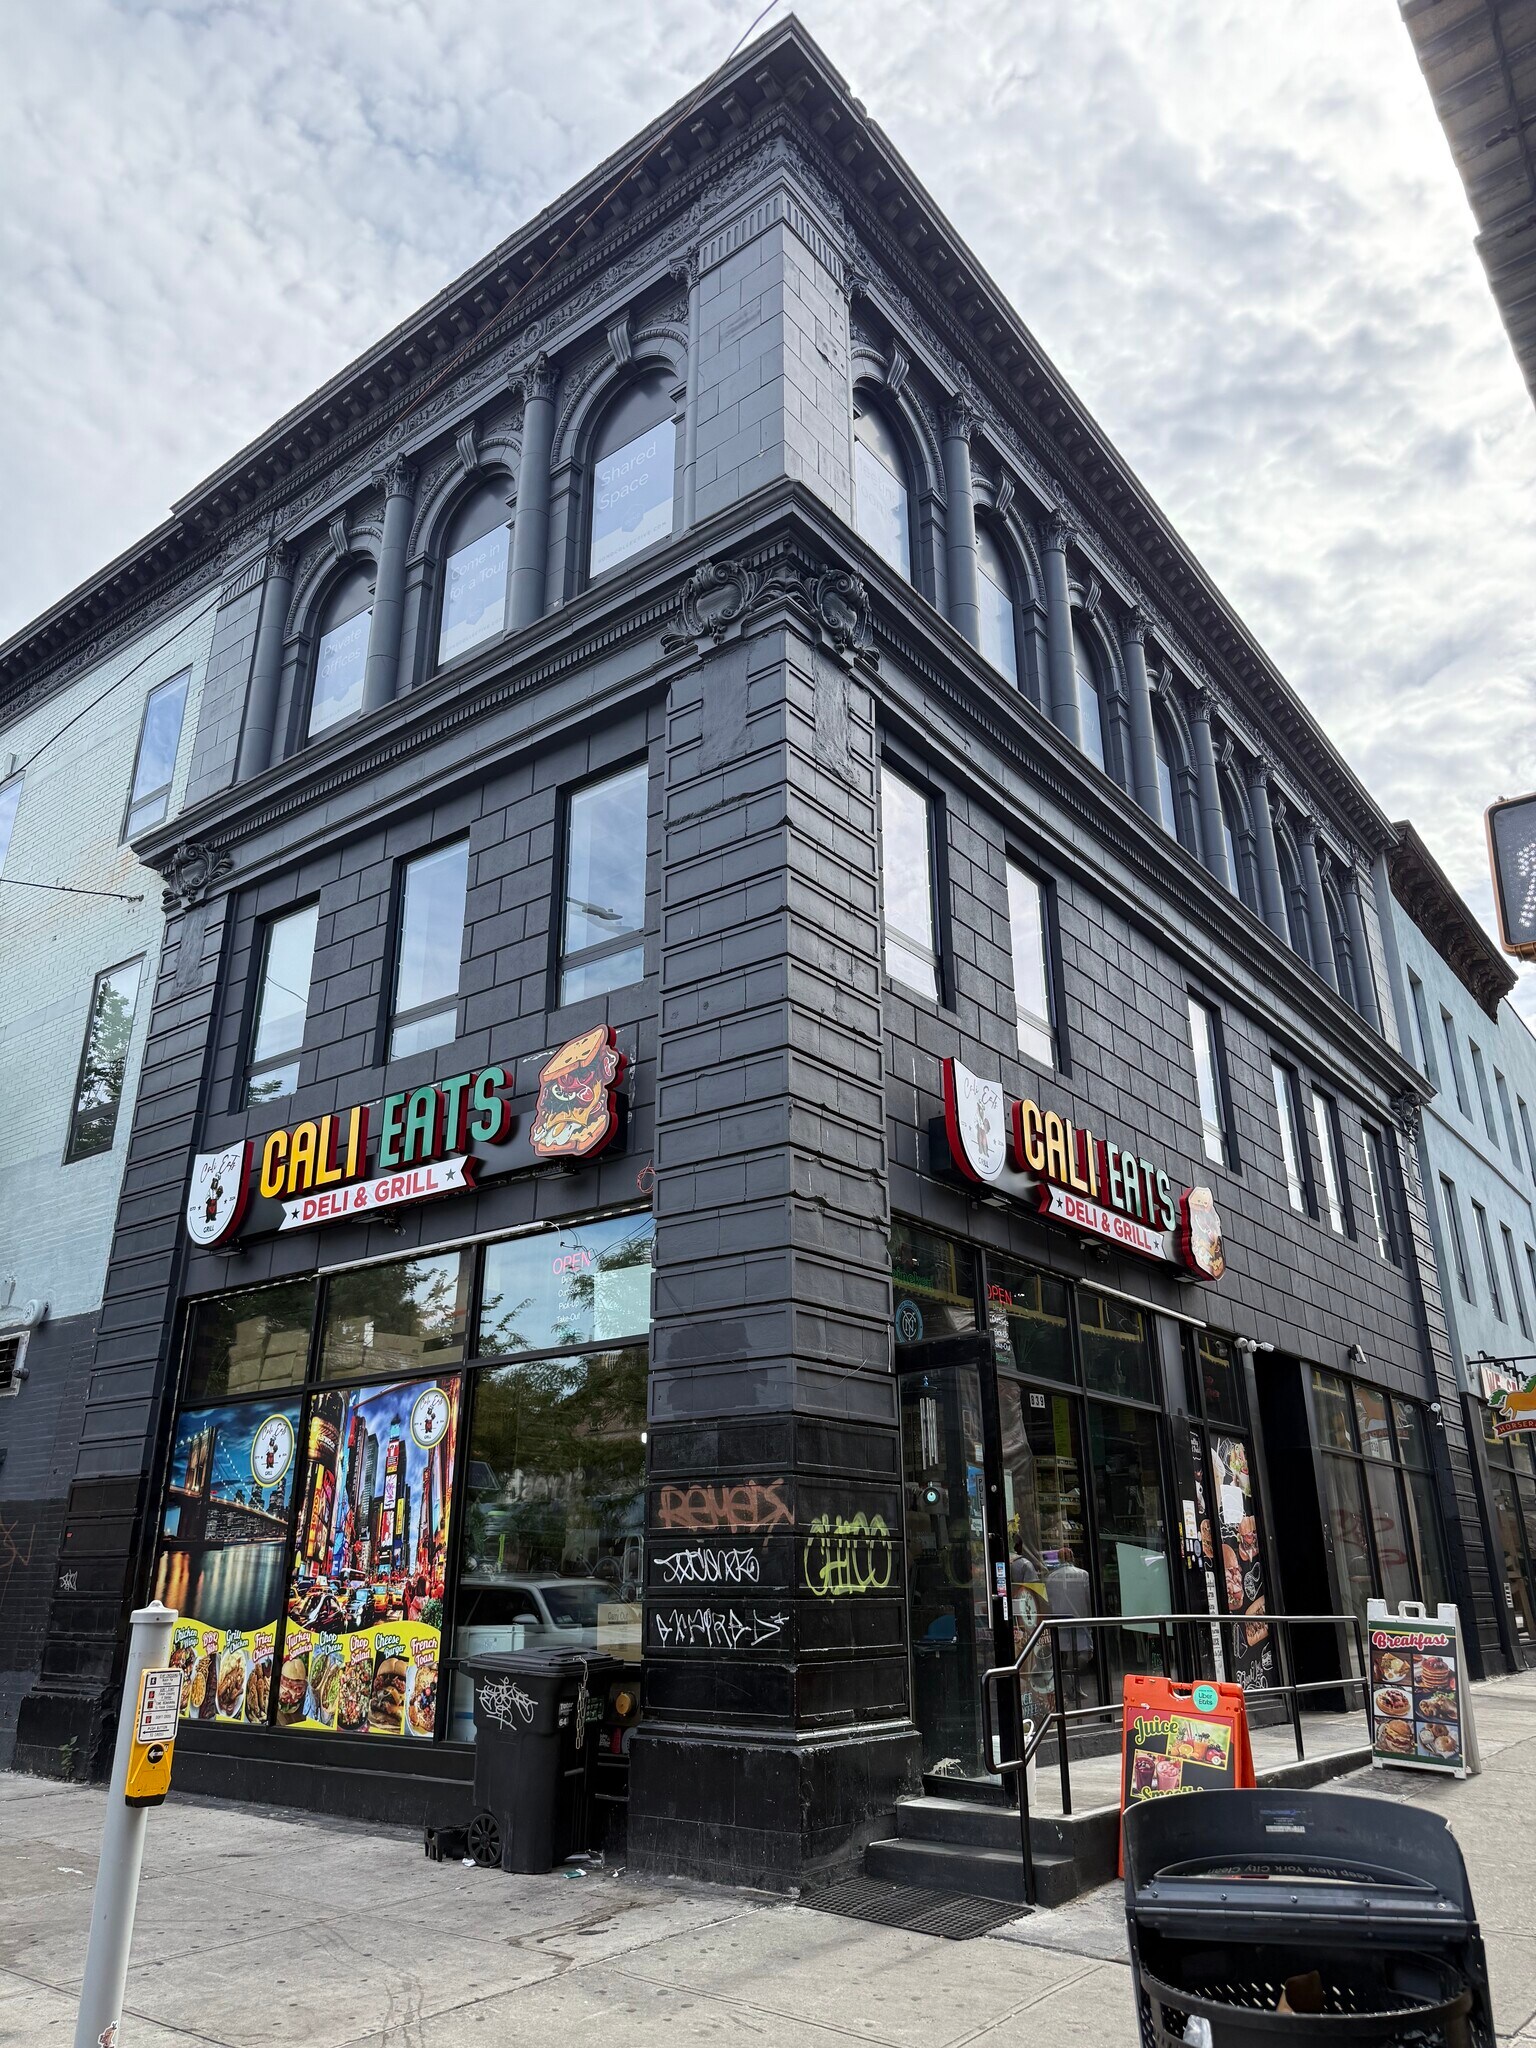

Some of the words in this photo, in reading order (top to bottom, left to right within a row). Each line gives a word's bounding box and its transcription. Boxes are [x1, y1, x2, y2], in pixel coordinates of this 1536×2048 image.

[601, 441, 656, 487] Shared
[599, 473, 649, 510] Space
[451, 552, 487, 580] Come
[489, 543, 500, 558] in
[449, 585, 464, 600] for
[469, 580, 476, 591] a
[480, 560, 506, 583] Tour
[323, 628, 362, 659] Private
[320, 648, 361, 678] Offices
[260, 1105, 364, 1199] CALI
[379, 1066, 510, 1169] EATS
[1018, 1098, 1098, 1198] CALI
[1104, 1140, 1177, 1232] EATS
[302, 1188, 351, 1223] DELI
[354, 1187, 368, 1207] &
[375, 1167, 440, 1204] GRILL
[1064, 1194, 1098, 1228] DELI
[1101, 1212, 1111, 1233] &
[1113, 1217, 1153, 1251] GRILL
[552, 1250, 592, 1276] OPEN
[174, 1626, 198, 1644] Chicken
[202, 1631, 219, 1645] BBQ
[226, 1629, 242, 1647] Grill
[255, 1632, 273, 1648] Fried
[286, 1631, 311, 1648] Turkey
[319, 1630, 338, 1646] Chop
[350, 1634, 369, 1651] Chop
[375, 1633, 401, 1650] Cheese
[1372, 1631, 1449, 1650] Breakfast
[229, 1639, 249, 1654] Chicken
[252, 1645, 274, 1663] Chicken
[289, 1642, 312, 1660] Sandwich
[325, 1643, 343, 1655] Cheese
[384, 1643, 406, 1659] Burger
[411, 1637, 438, 1655] French
[350, 1649, 371, 1665] Salad
[415, 1652, 435, 1667] Toast
[1134, 1715, 1178, 1745] Juice
[1207, 1866, 1242, 1875] Clean
[1244, 1864, 1271, 1873] City
[1275, 1865, 1305, 1874] York
[1308, 1867, 1337, 1877] New
[1339, 1869, 1376, 1882] Keep
